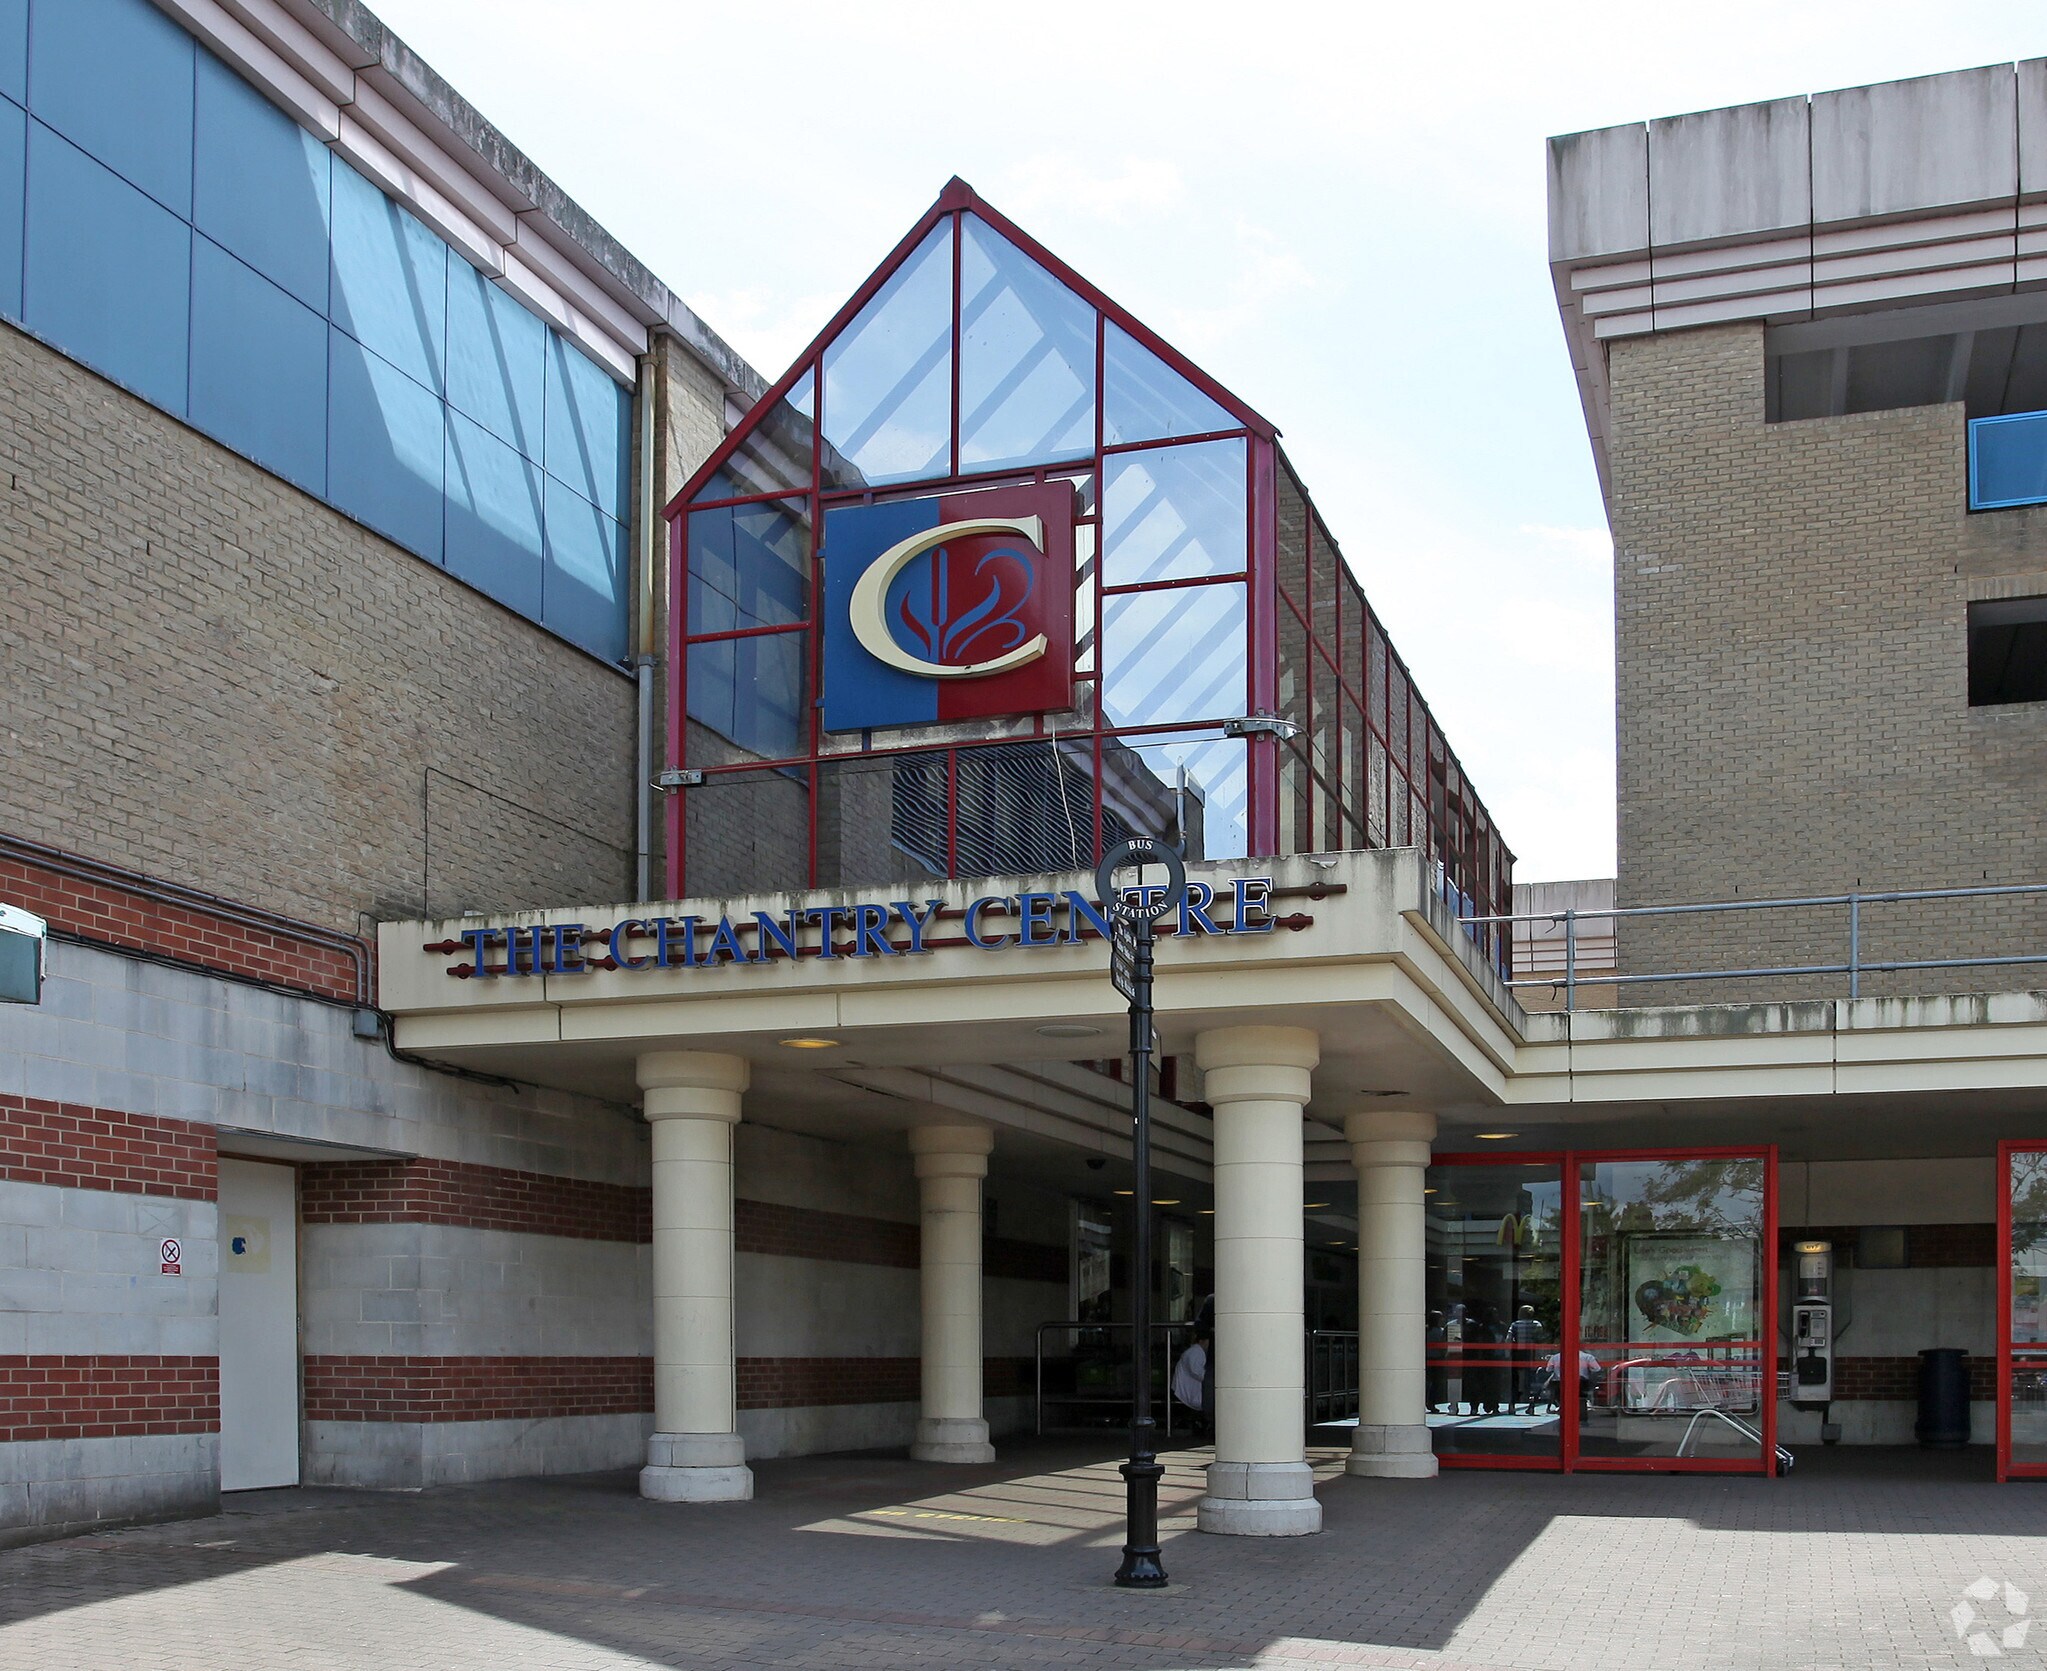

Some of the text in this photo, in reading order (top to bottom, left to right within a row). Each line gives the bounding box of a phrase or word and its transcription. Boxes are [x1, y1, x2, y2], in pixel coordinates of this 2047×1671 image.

[1127, 838, 1154, 851] BUS
[1112, 901, 1169, 919] STATION
[461, 923, 586, 980] THE
[608, 898, 949, 973] CHANTRY
